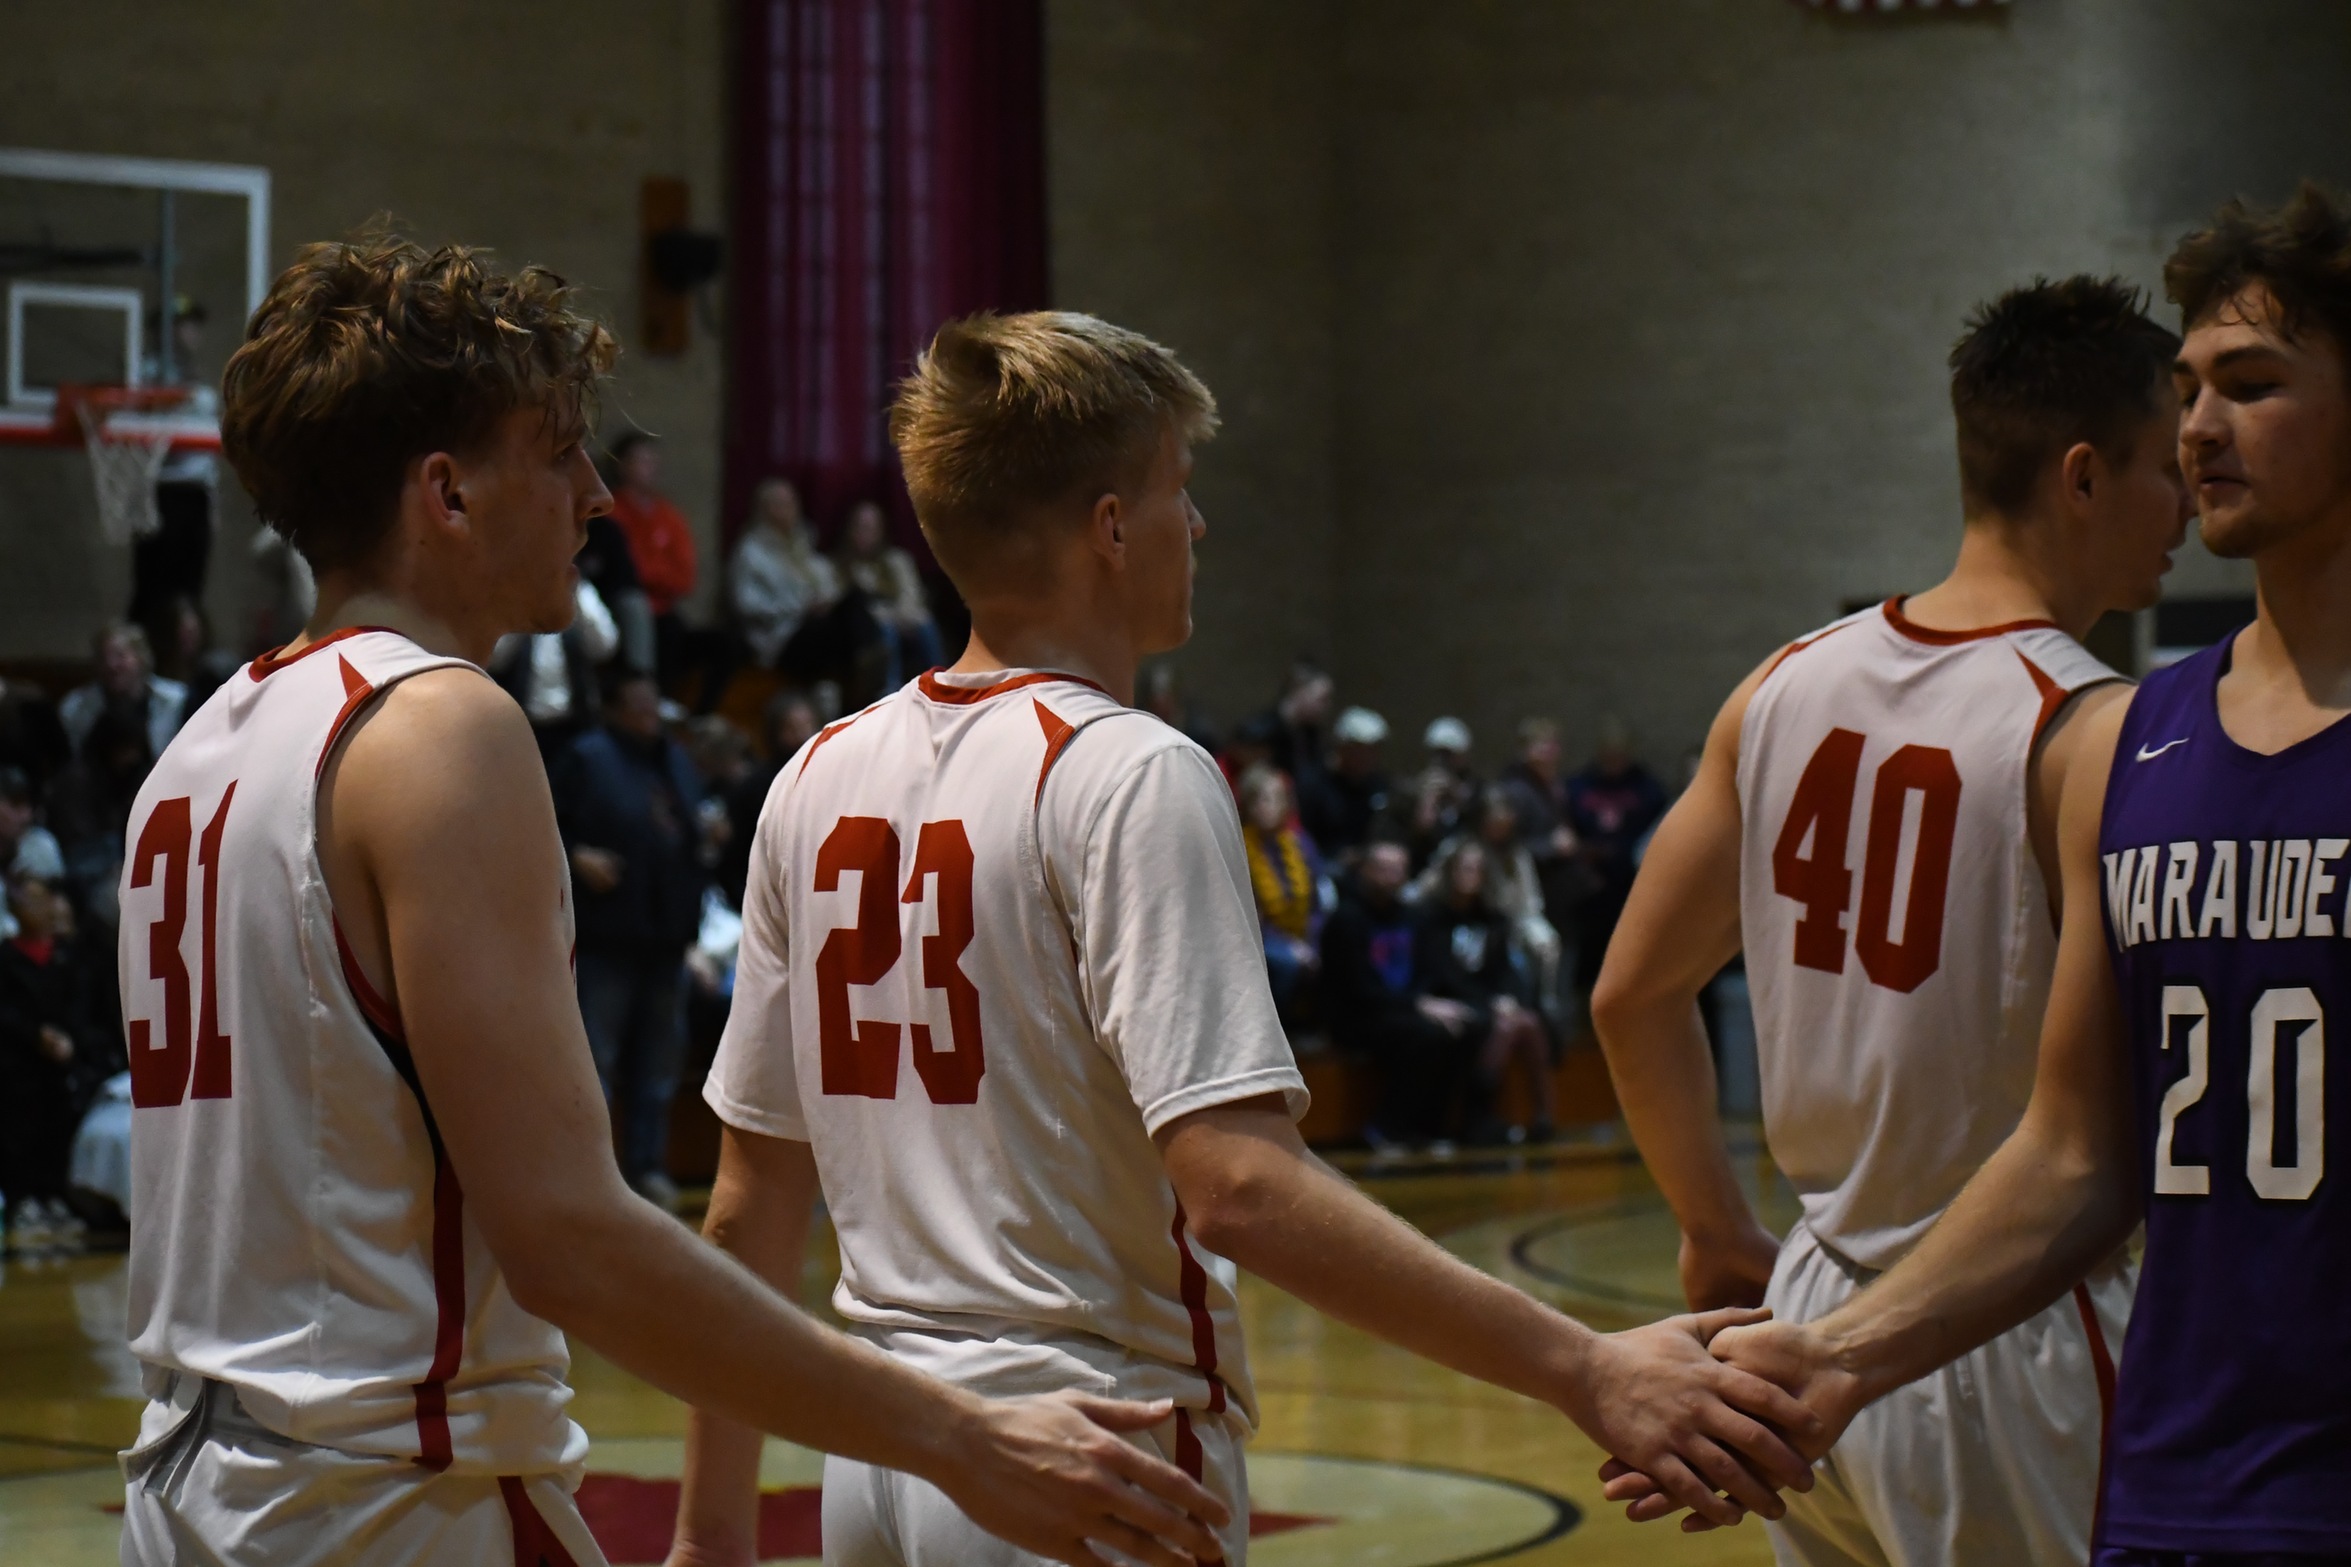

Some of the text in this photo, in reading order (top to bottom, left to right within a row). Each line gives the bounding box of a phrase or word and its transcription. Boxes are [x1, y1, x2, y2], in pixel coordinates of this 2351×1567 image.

[129, 778, 239, 1109] 31
[814, 816, 986, 1105] 23
[1773, 728, 1962, 993] 40
[2102, 838, 2351, 953] MARAUDE
[2154, 985, 2325, 1201] 20
